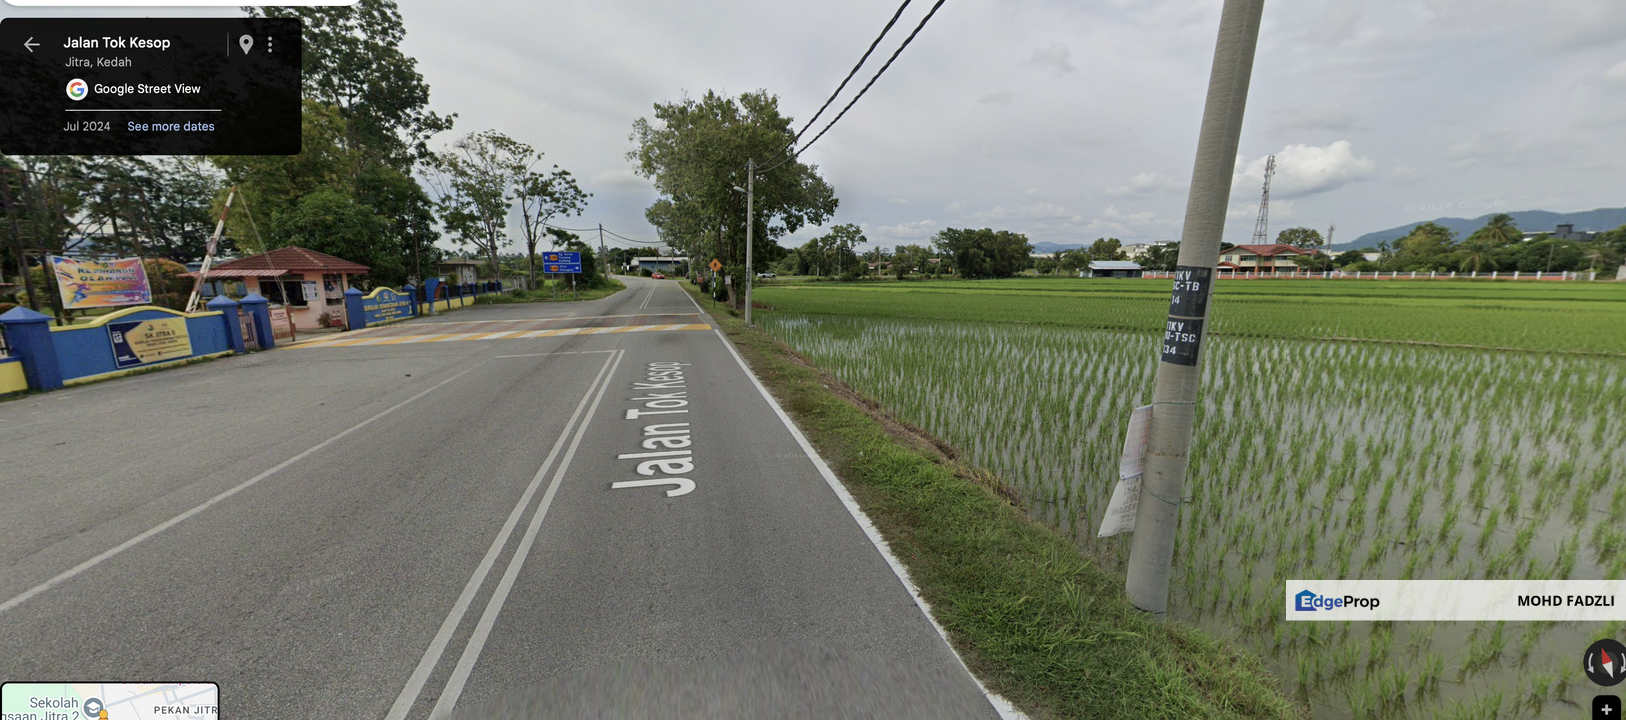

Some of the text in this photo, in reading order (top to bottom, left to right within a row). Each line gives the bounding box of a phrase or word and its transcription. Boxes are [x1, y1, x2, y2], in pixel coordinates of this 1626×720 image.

[611, 361, 697, 497] Jalan Tok Kesop
